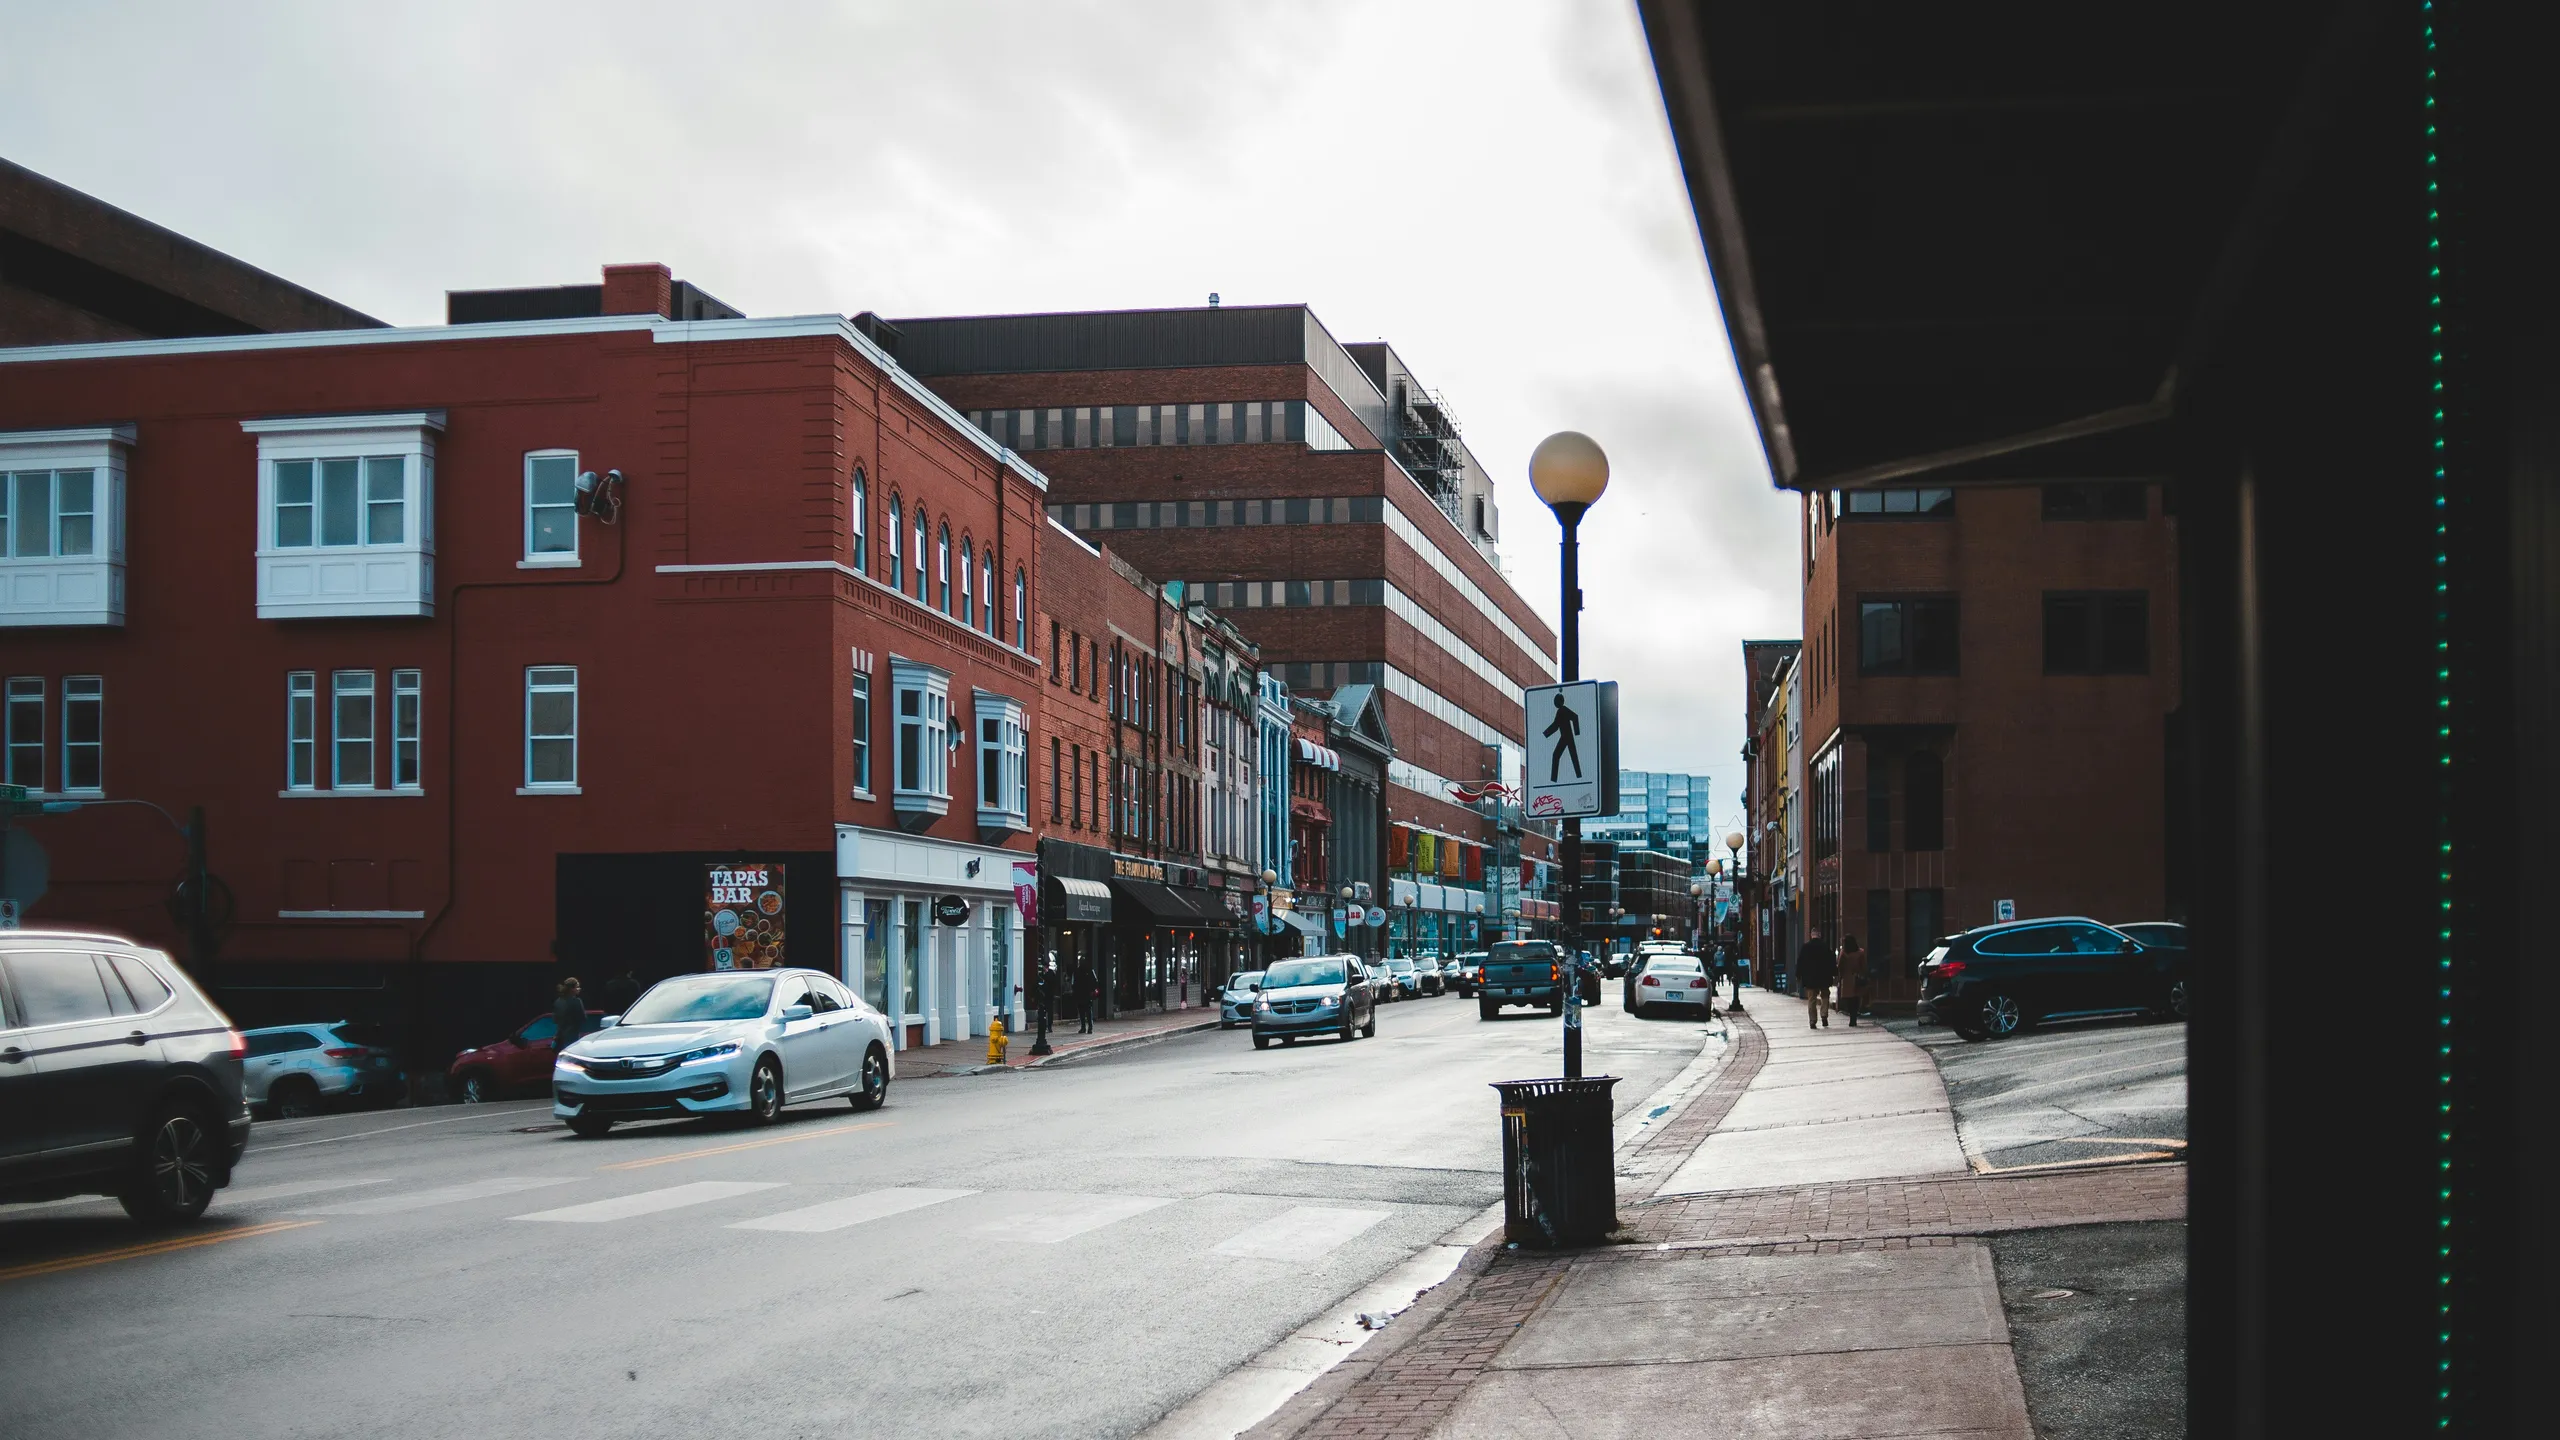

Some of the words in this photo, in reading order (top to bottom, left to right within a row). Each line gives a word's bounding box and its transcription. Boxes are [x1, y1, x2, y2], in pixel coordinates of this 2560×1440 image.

[1114, 859, 1125, 875] THE
[710, 871, 768, 887] TAPAS
[712, 887, 753, 904] BAR
